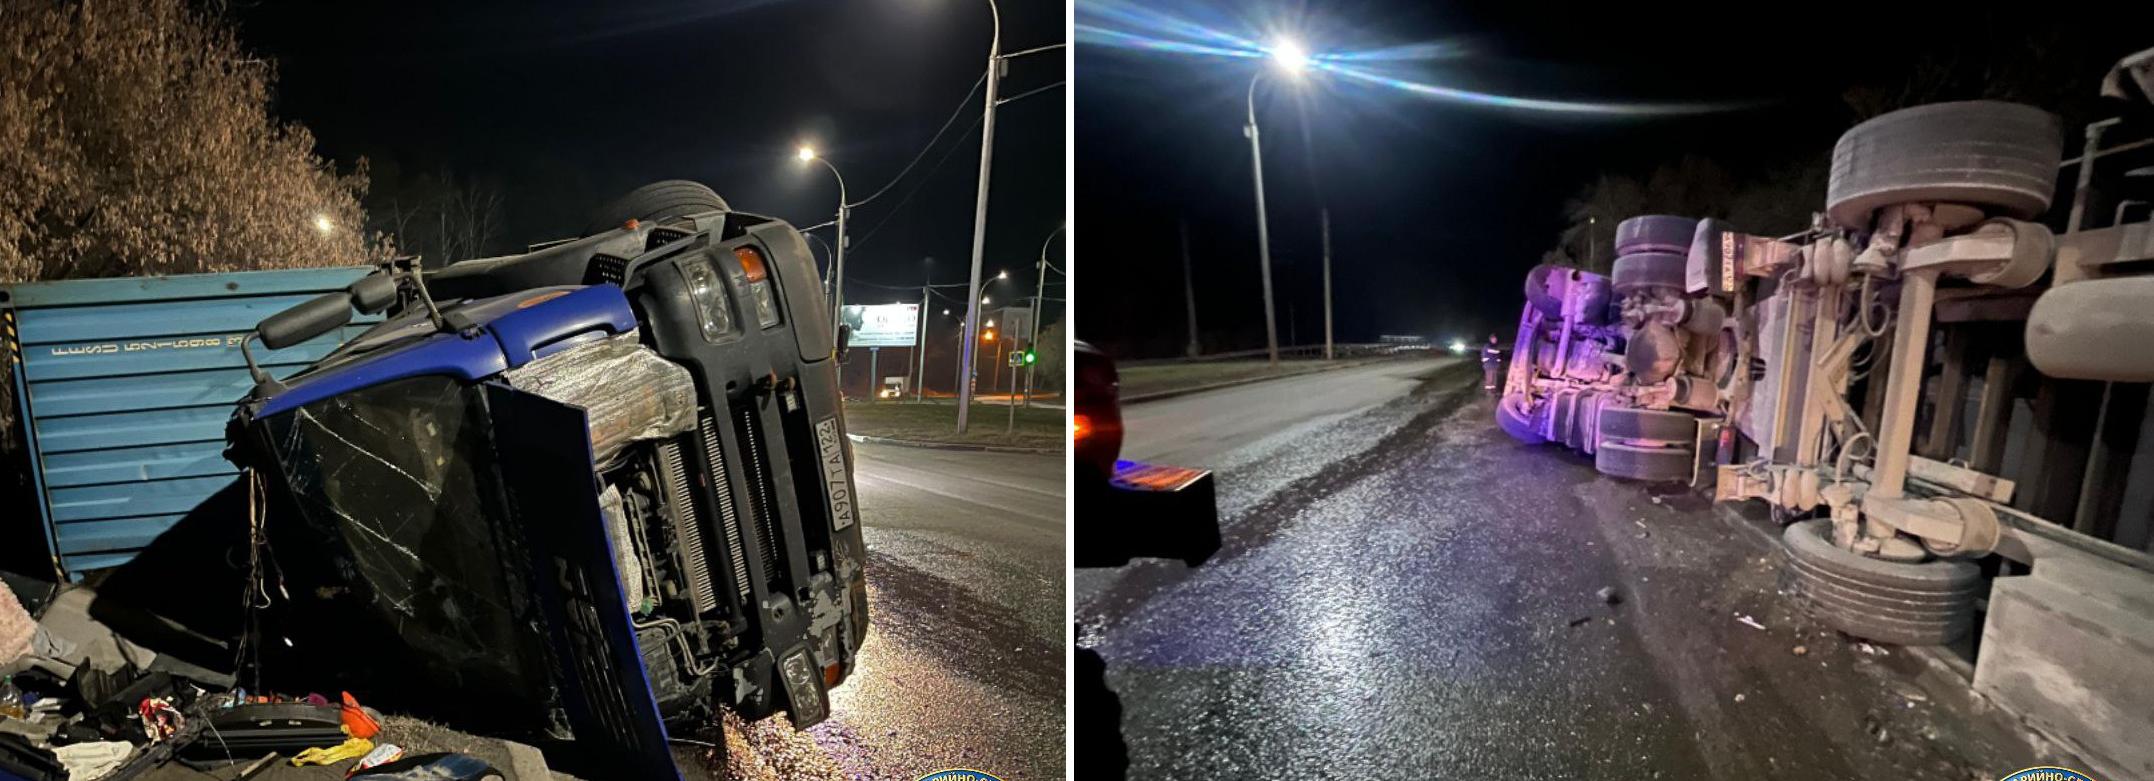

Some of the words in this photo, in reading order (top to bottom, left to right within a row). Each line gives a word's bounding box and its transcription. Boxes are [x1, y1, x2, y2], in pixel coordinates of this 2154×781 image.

[51, 344, 119, 356] FESU
[819, 425, 833, 453] 122
[829, 453, 850, 520] А907ТА
